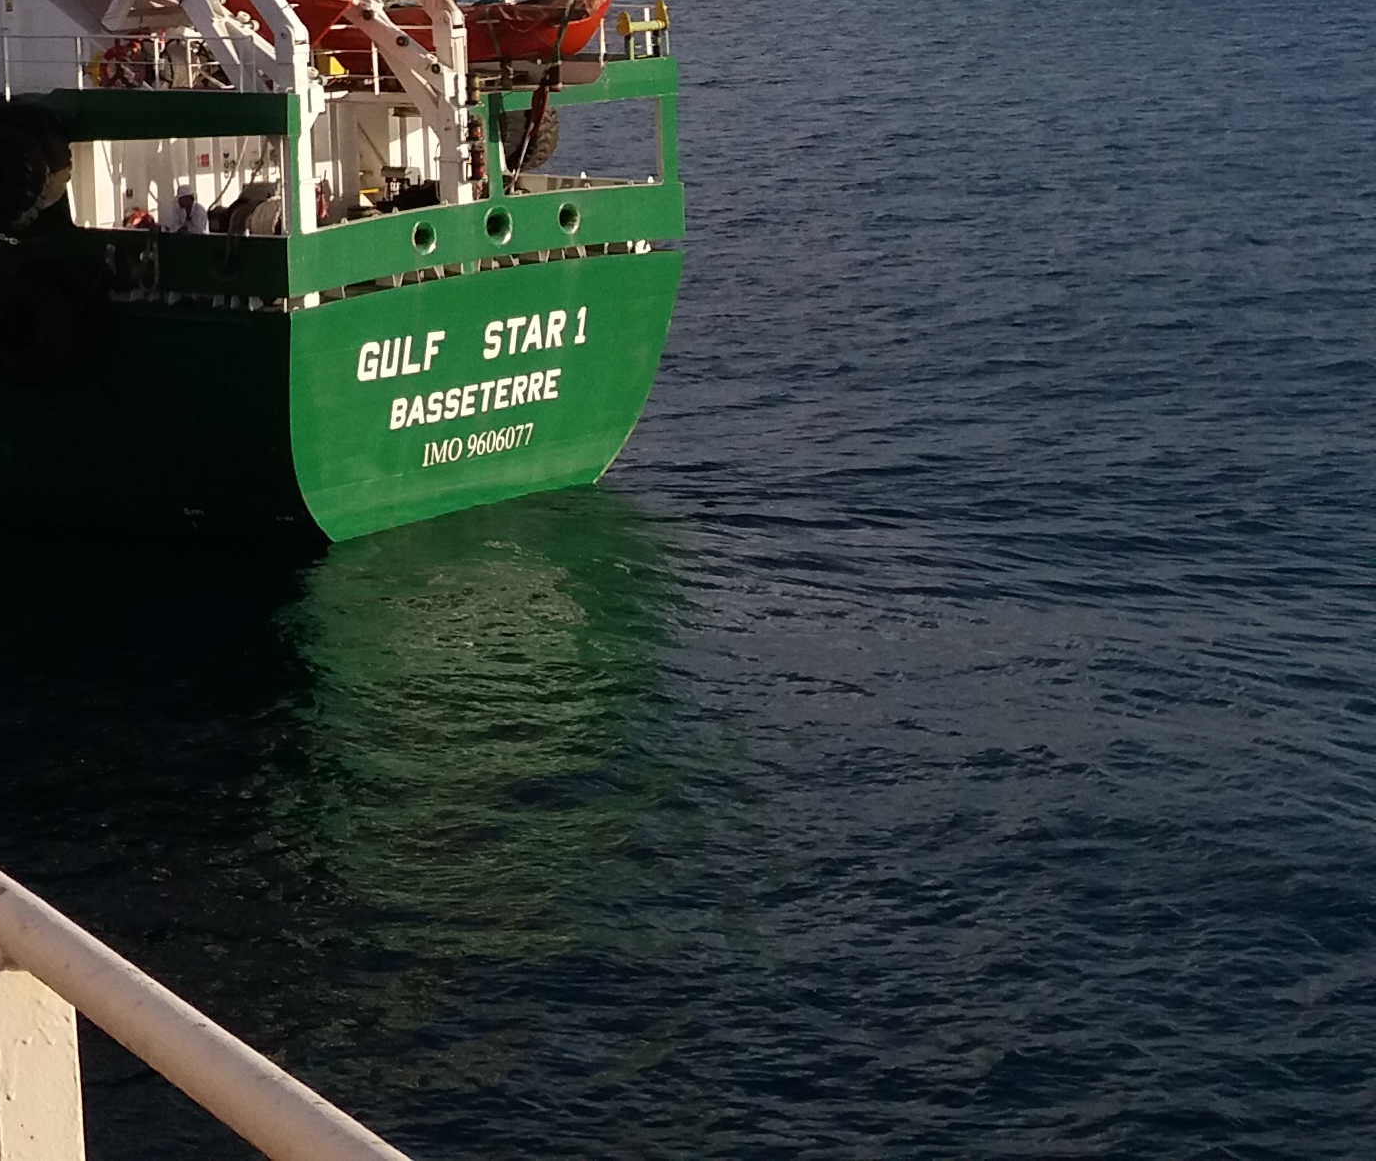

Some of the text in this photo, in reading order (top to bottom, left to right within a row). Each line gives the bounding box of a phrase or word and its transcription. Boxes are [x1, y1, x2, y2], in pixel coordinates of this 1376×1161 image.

[357, 306, 587, 382] GULF STAR 1
[389, 368, 562, 430] BASSETERRE
[422, 422, 534, 467] IMO 9606077
